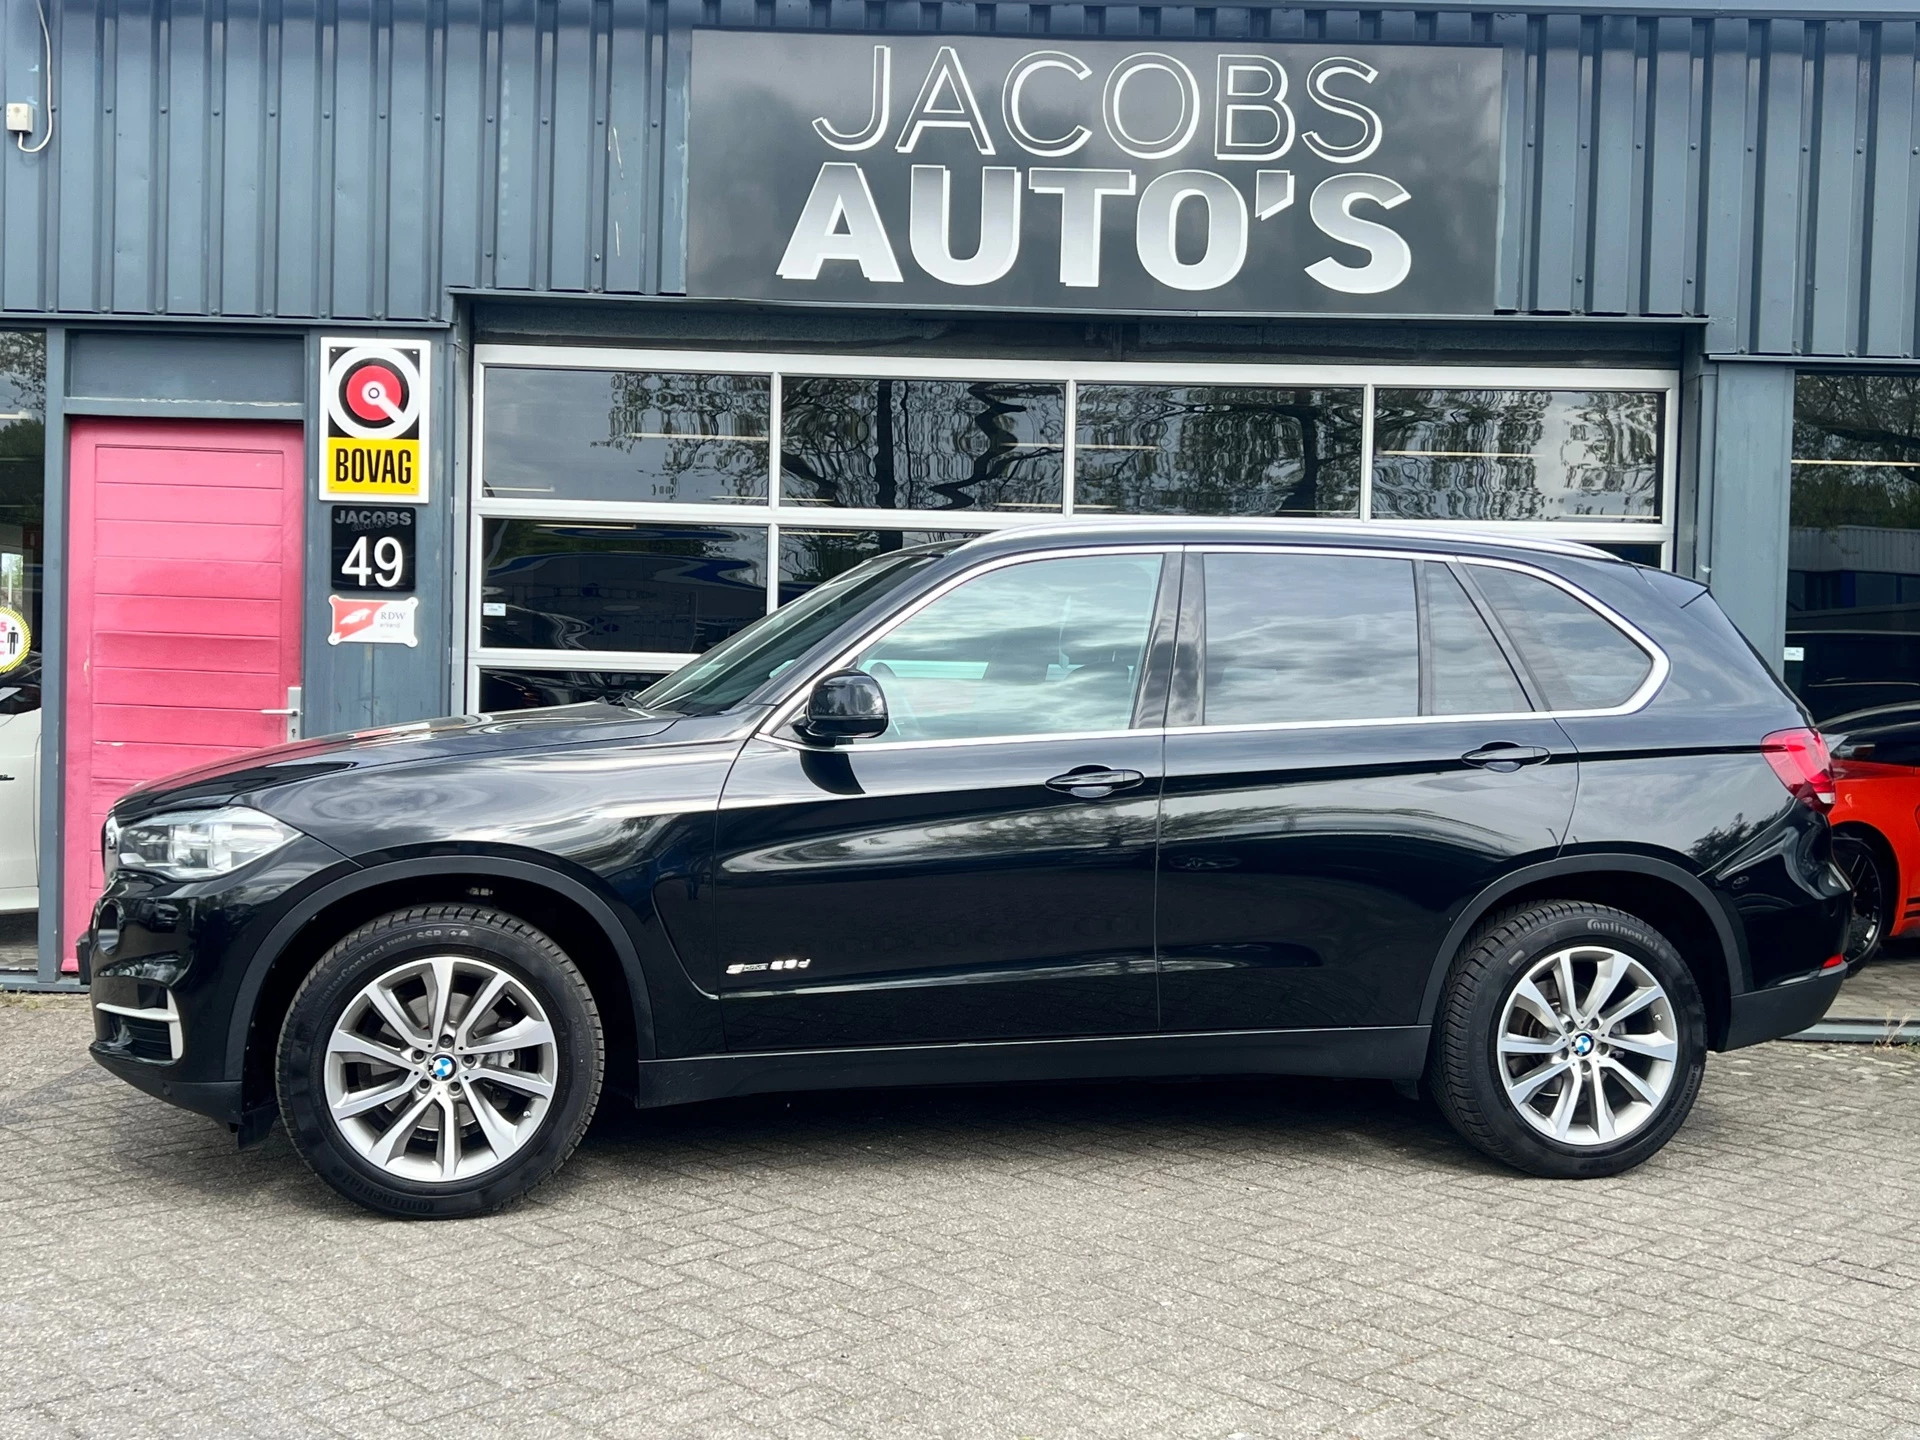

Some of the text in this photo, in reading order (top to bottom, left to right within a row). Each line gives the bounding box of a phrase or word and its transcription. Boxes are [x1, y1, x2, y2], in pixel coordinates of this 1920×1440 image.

[812, 45, 1383, 164] JACOBS
[776, 161, 1412, 294] AUTO'S
[335, 448, 412, 484] BOVAG
[334, 510, 412, 526] JACOBS
[341, 536, 403, 588] 49
[380, 611, 406, 620] RDW
[1587, 918, 1659, 950] Continental
